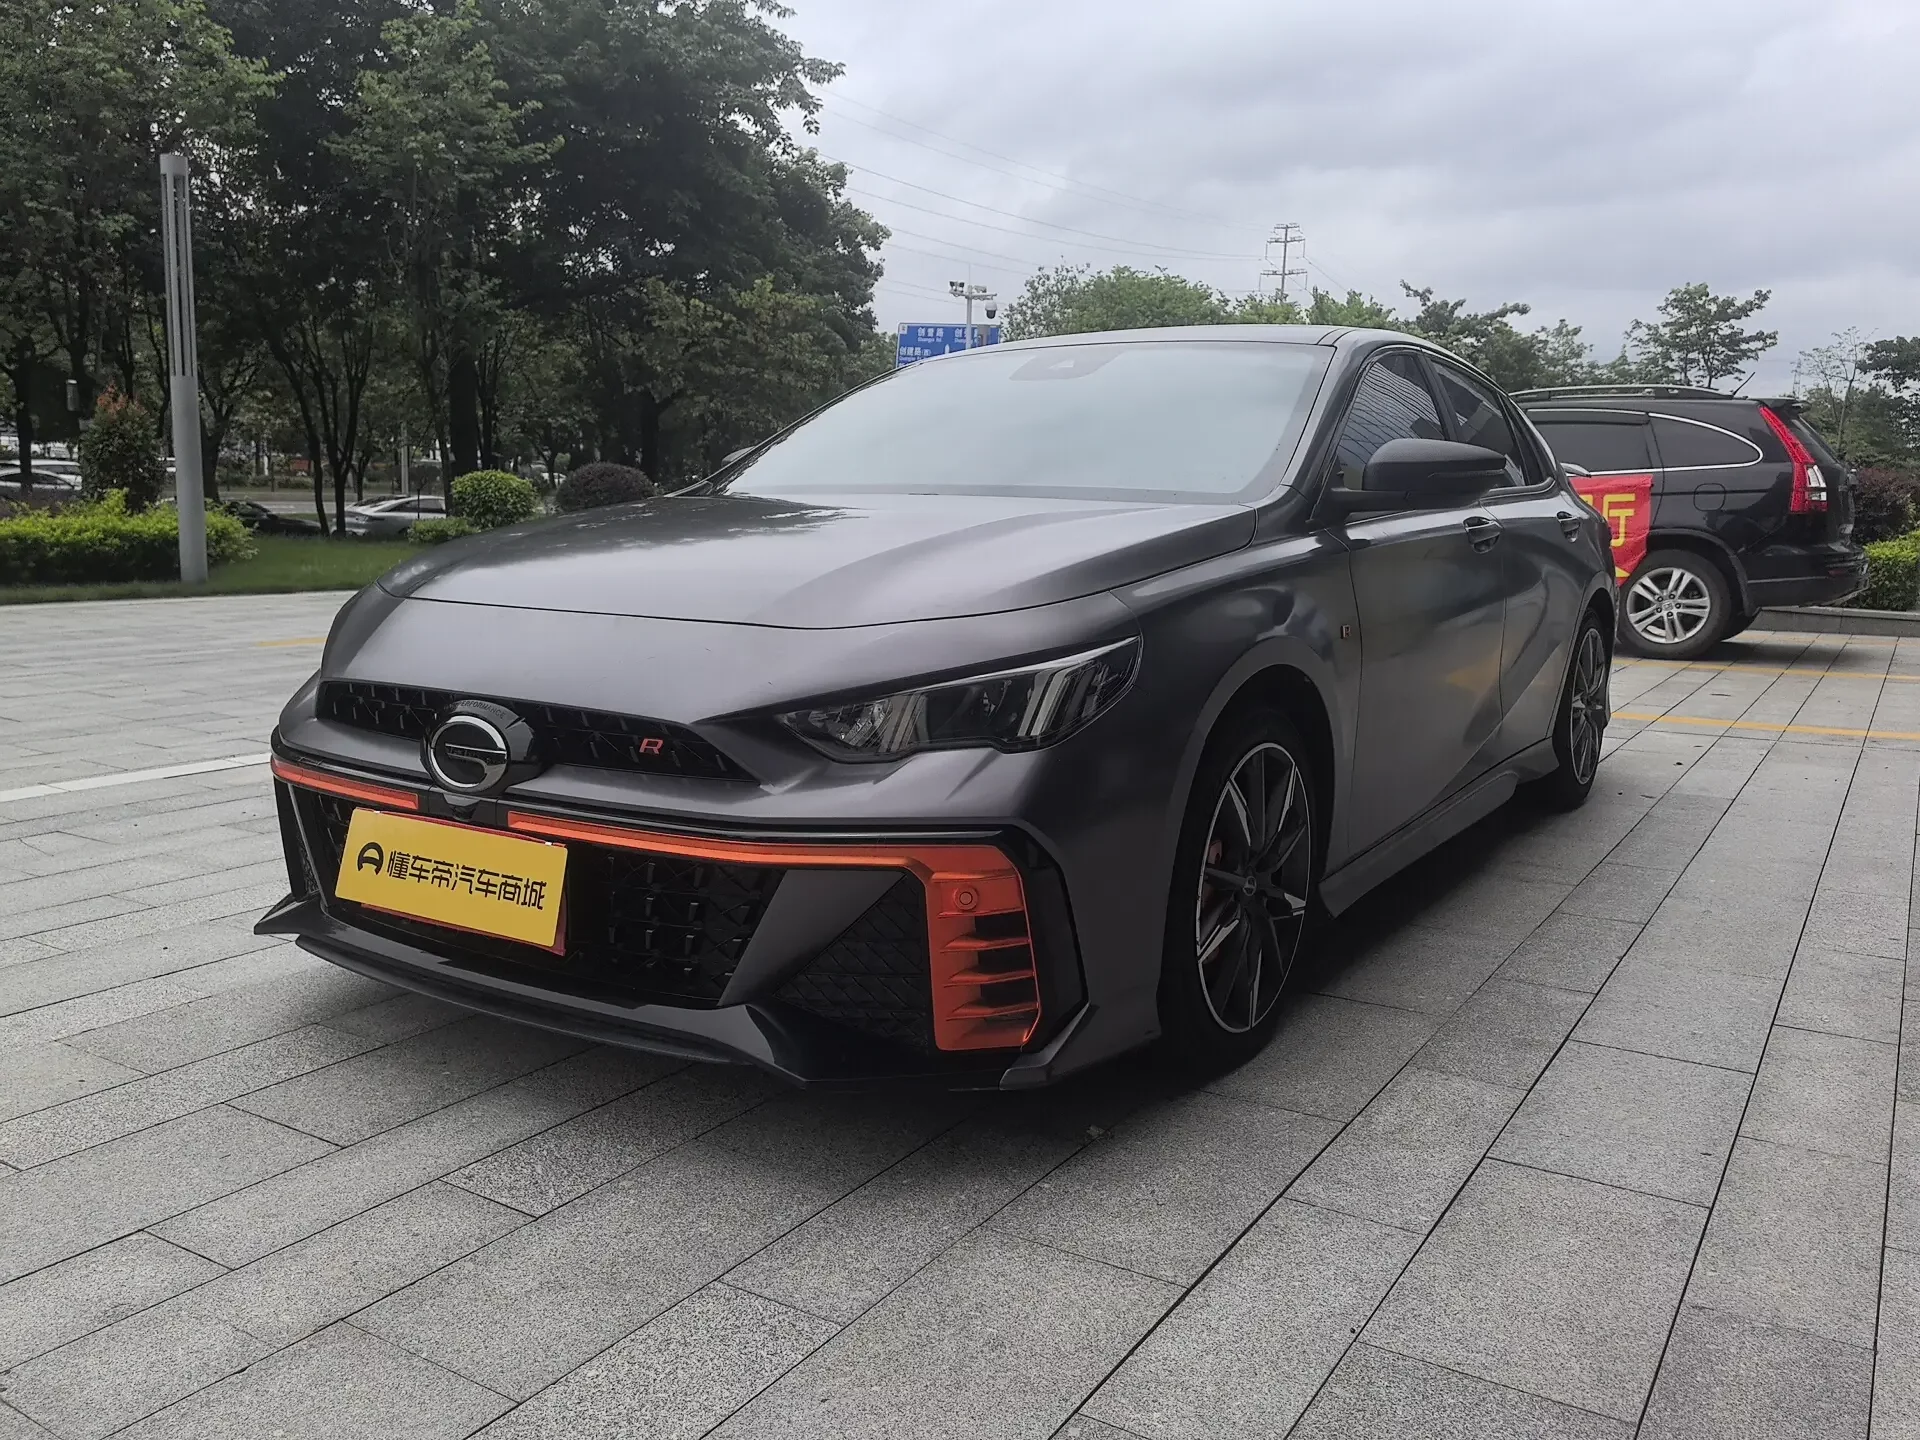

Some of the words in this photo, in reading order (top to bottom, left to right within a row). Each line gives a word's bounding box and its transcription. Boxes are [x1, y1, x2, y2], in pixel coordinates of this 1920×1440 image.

[639, 738, 663, 754] R
[387, 850, 547, 910] 懂车帝汽车商城
